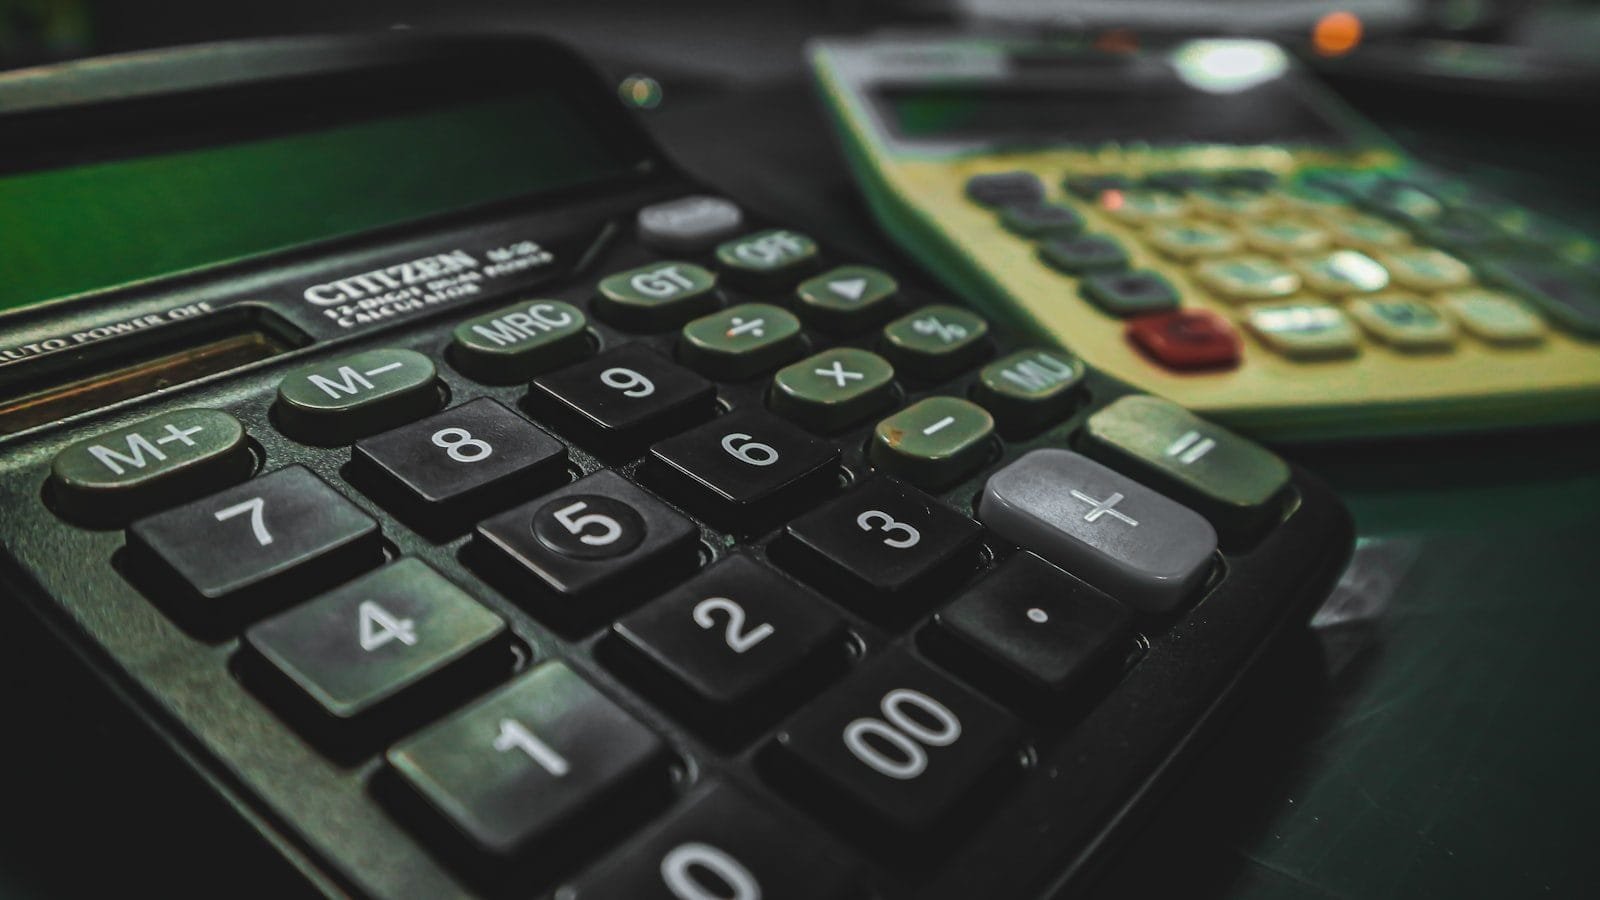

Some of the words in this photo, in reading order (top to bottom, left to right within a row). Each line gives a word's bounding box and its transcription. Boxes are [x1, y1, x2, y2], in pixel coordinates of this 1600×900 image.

[734, 230, 803, 264] OFF
[303, 249, 479, 306] CITIZEN
[631, 265, 695, 299] GT
[72, 315, 163, 343] POWER
[473, 303, 573, 348] MRC
[600, 367, 655, 398] 9
[1001, 352, 1073, 391] MU
[86, 421, 204, 477] M+
[431, 427, 493, 464] 8
[721, 432, 779, 466] 6
[214, 497, 273, 546] 7
[551, 501, 622, 546] 5
[856, 509, 921, 549] 3
[358, 601, 417, 651] 4
[692, 597, 774, 653] 2
[492, 717, 568, 776] 1
[843, 688, 962, 780] 00
[660, 842, 761, 900] 0
